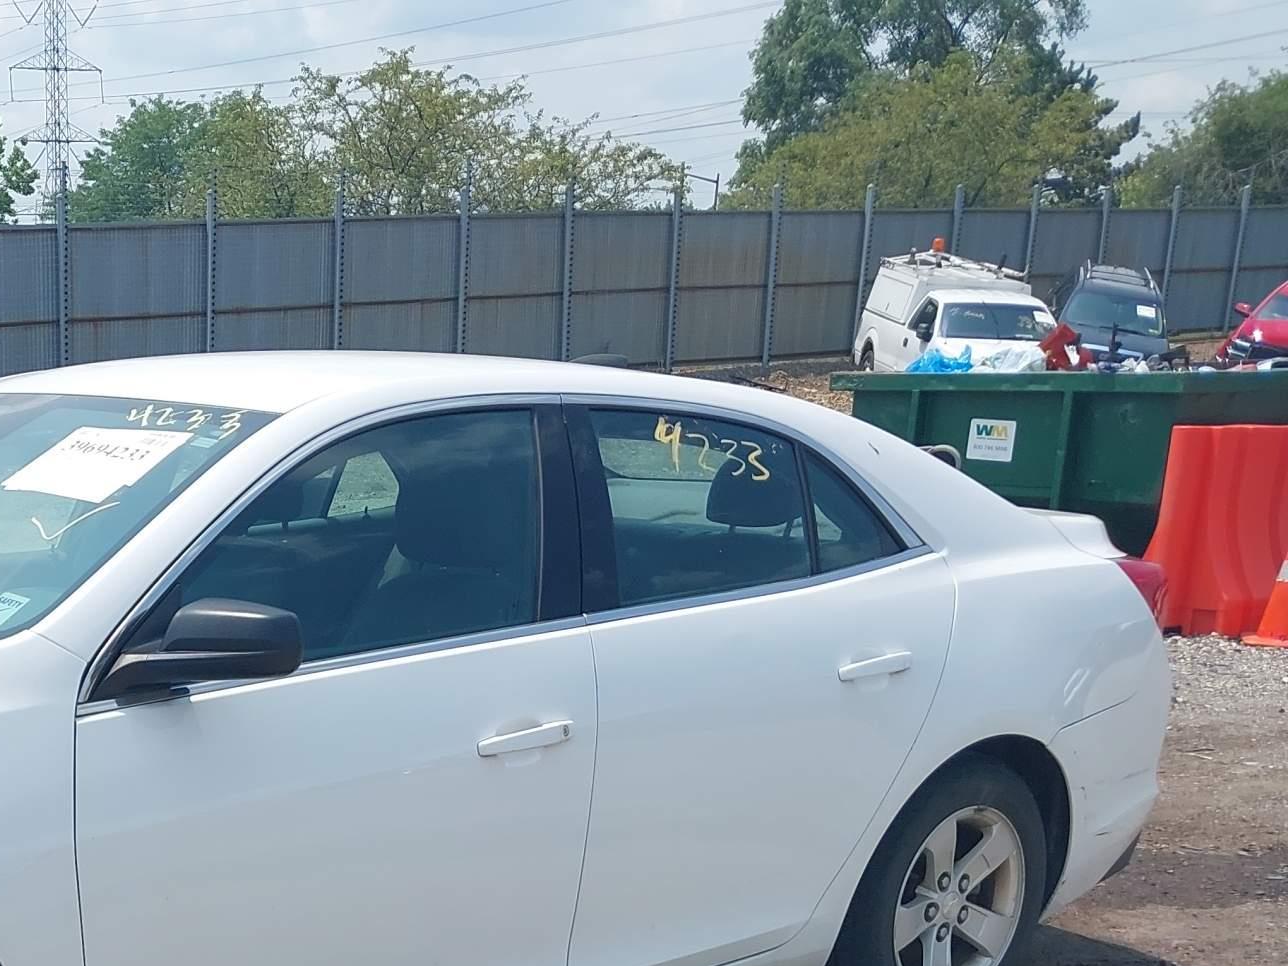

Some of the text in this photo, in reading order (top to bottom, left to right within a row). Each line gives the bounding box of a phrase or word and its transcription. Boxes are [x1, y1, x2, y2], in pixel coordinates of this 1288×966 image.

[126, 404, 247, 441] 4233
[975, 423, 1009, 438] WM
[655, 415, 770, 481] 4233
